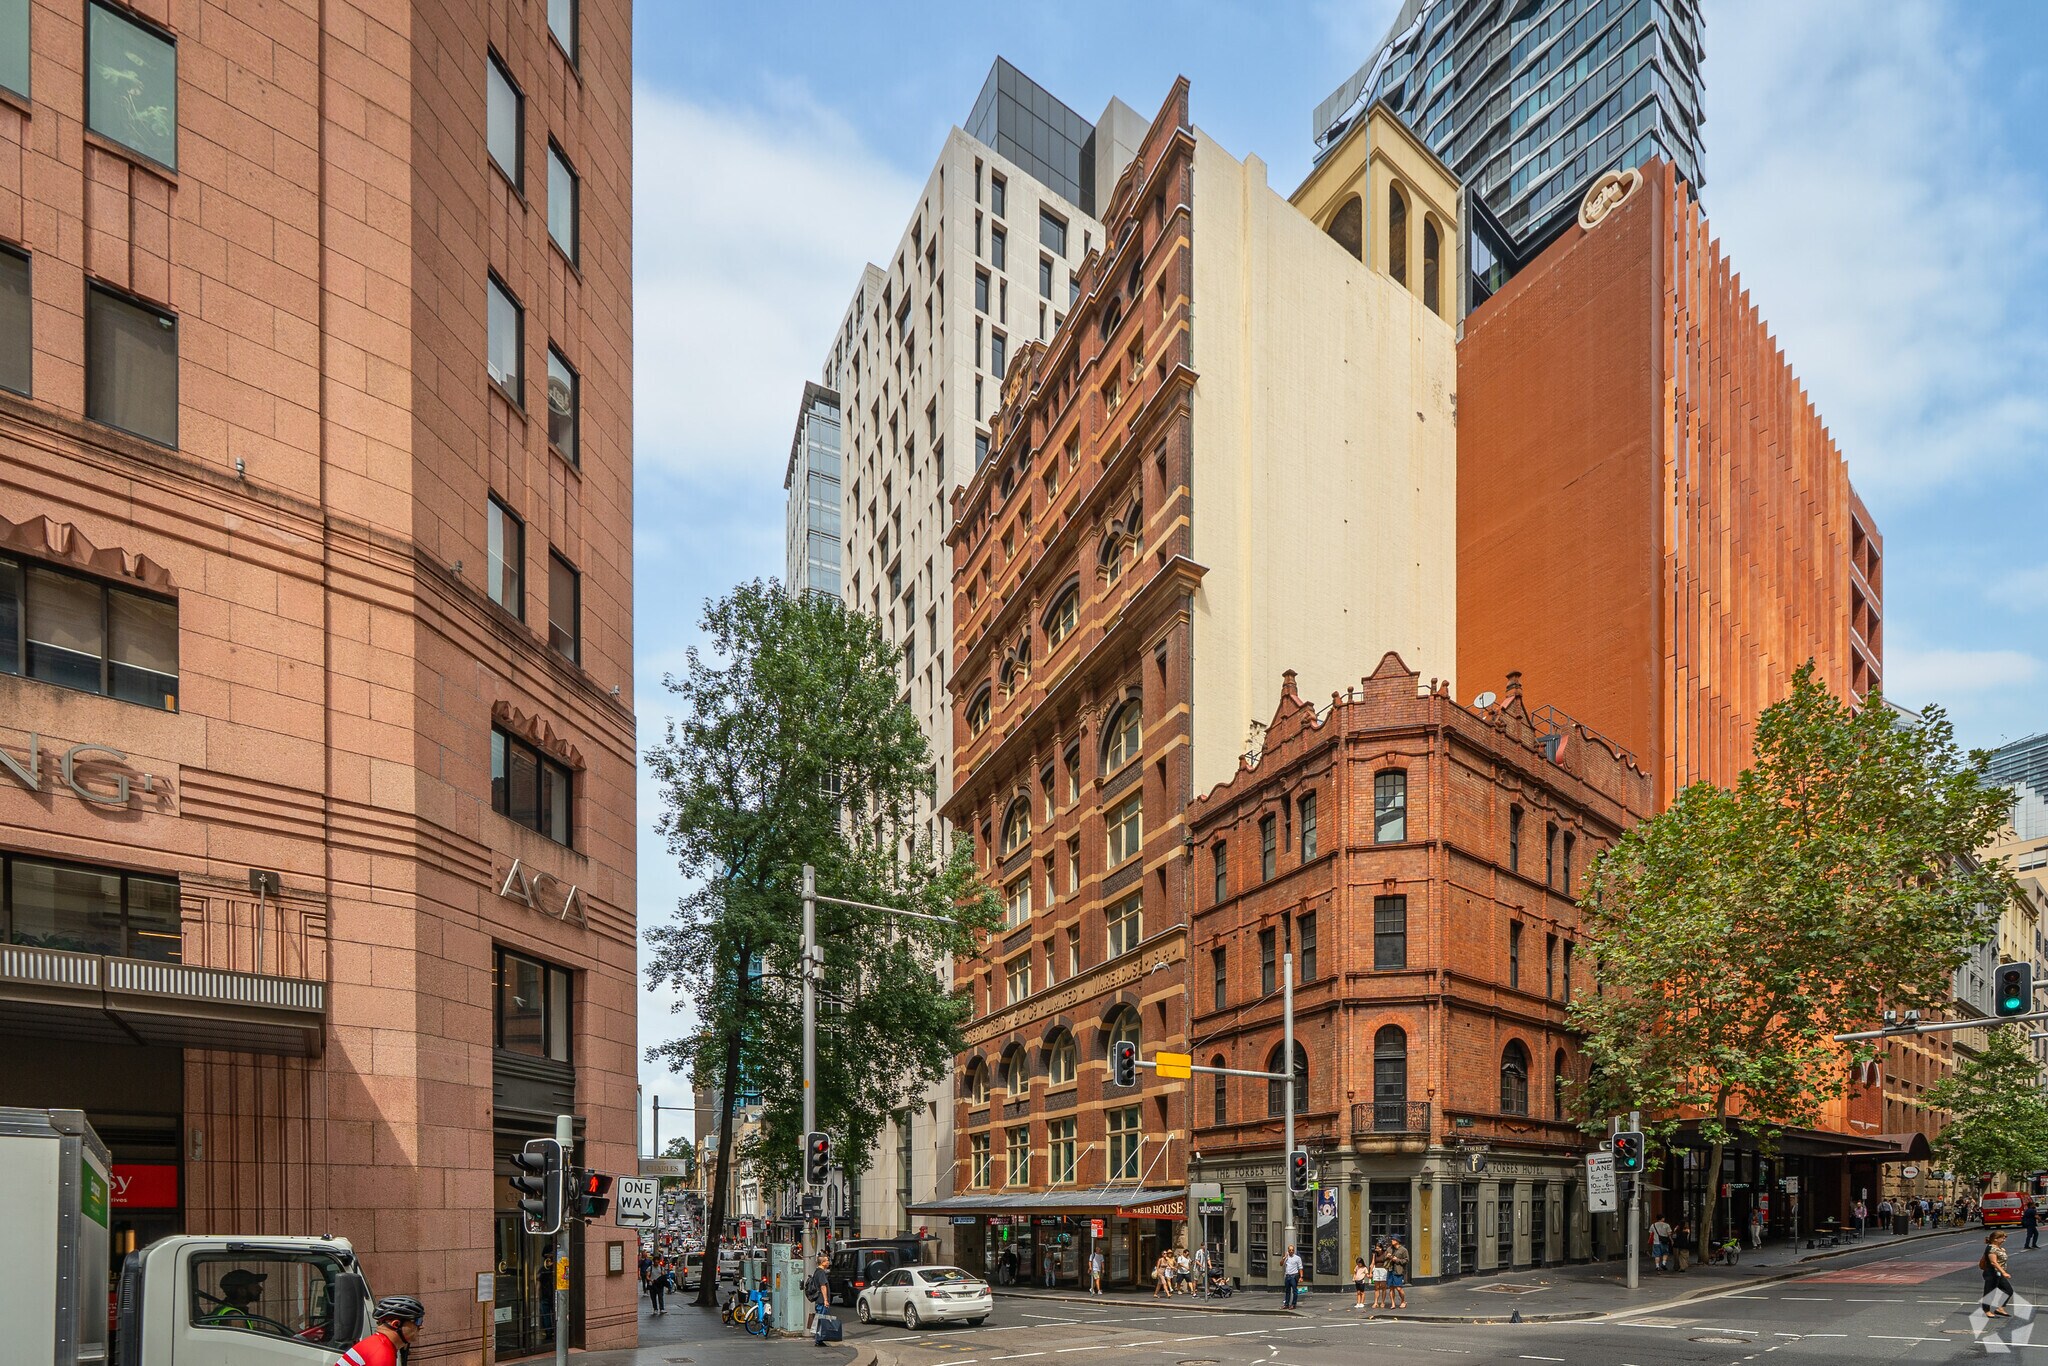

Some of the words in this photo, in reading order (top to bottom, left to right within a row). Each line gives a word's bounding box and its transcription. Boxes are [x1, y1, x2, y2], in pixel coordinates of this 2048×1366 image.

[500, 858, 589, 931] ACA
[646, 1164, 679, 1173] CHARLES
[1216, 1168, 1230, 1179] THE
[1235, 1165, 1265, 1178] FORBES
[1492, 1162, 1519, 1174] FORBES
[1522, 1165, 1545, 1175] HOTEL
[1590, 1164, 1612, 1172] LANE
[624, 1181, 653, 1194] ONE
[621, 1196, 653, 1210] WAY
[1138, 1206, 1152, 1214] REID
[1152, 1201, 1184, 1215] HOUSE
